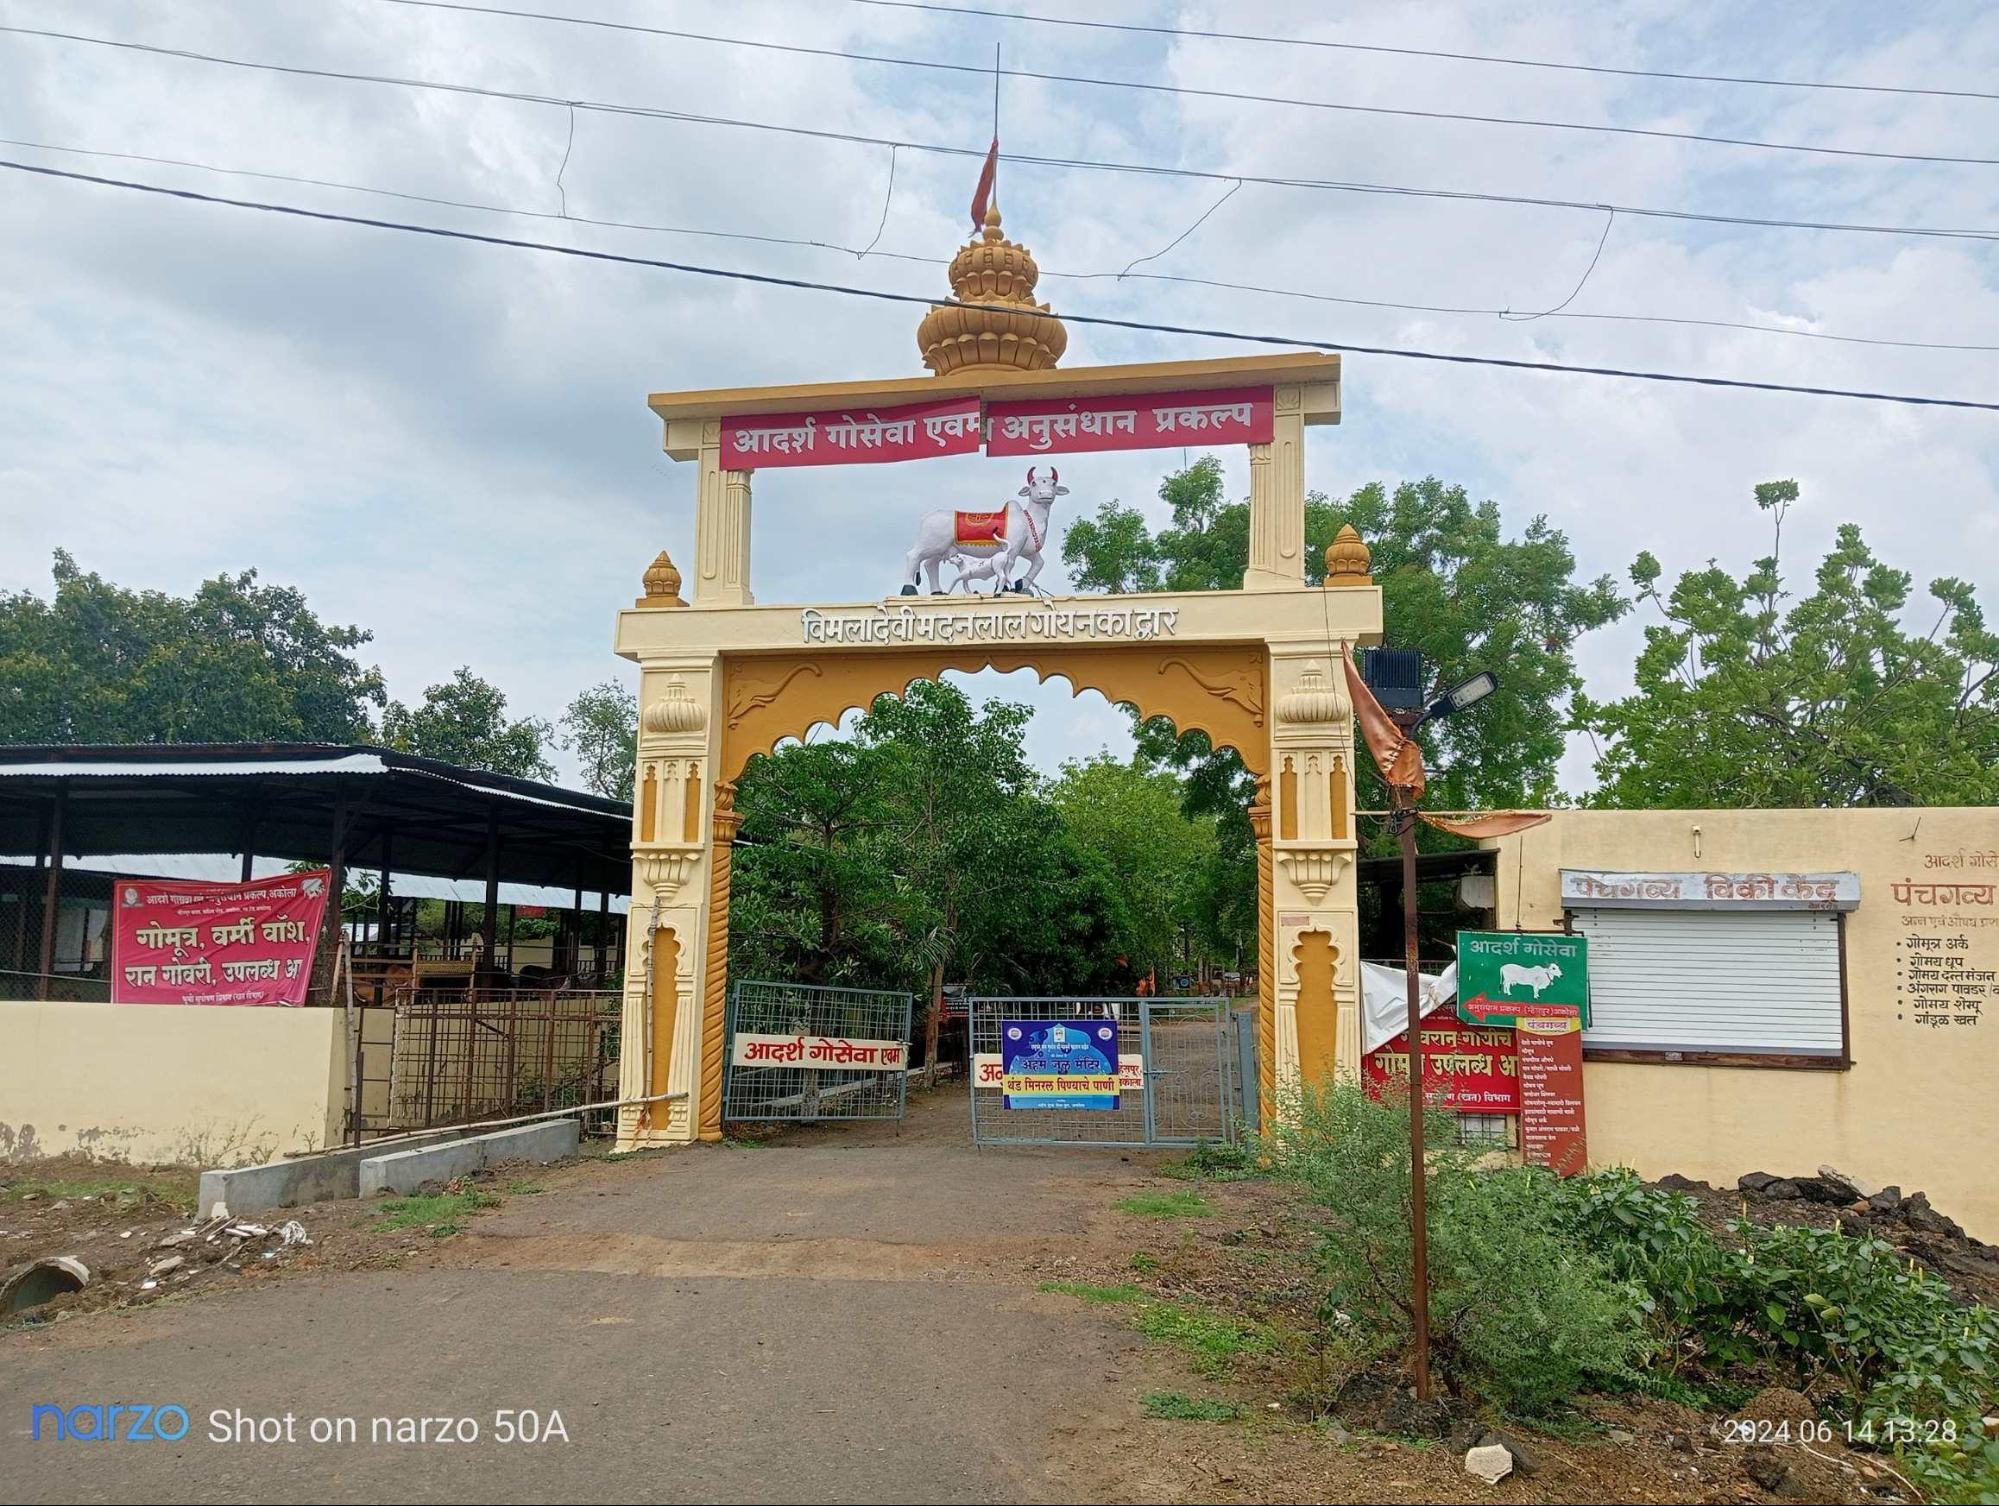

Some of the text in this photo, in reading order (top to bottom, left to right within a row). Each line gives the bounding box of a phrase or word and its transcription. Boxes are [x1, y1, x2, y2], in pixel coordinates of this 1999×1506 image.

[733, 415, 816, 454] आदर्श
[826, 411, 916, 449] गोसेवा
[1002, 403, 1138, 450] अनुसंधान
[1152, 402, 1253, 433] प्रकल्प
[1924, 848, 1966, 869] आदर्श
[1891, 877, 1997, 907] पंचगव्य
[135, 920, 205, 958] गोमूत्र,
[1470, 937, 1577, 957] आदर्श गोसेवा
[1945, 934, 1969, 950] अर्क
[1910, 952, 1965, 969] गोमय धूप
[125, 964, 157, 988] रान
[221, 958, 281, 985] उपलब्ध
[1908, 966, 1939, 981] गोमय
[1913, 996, 1950, 1009] गोमय
[1953, 1014, 1979, 1026] खत
[744, 1036, 805, 1063] आदर्श
[809, 1038, 878, 1064] गोसेवा
[1429, 1052, 1494, 1078] उपलब्ध
[1008, 1076, 1115, 1092] थंड मिनरल पिण्याचे पाणी
